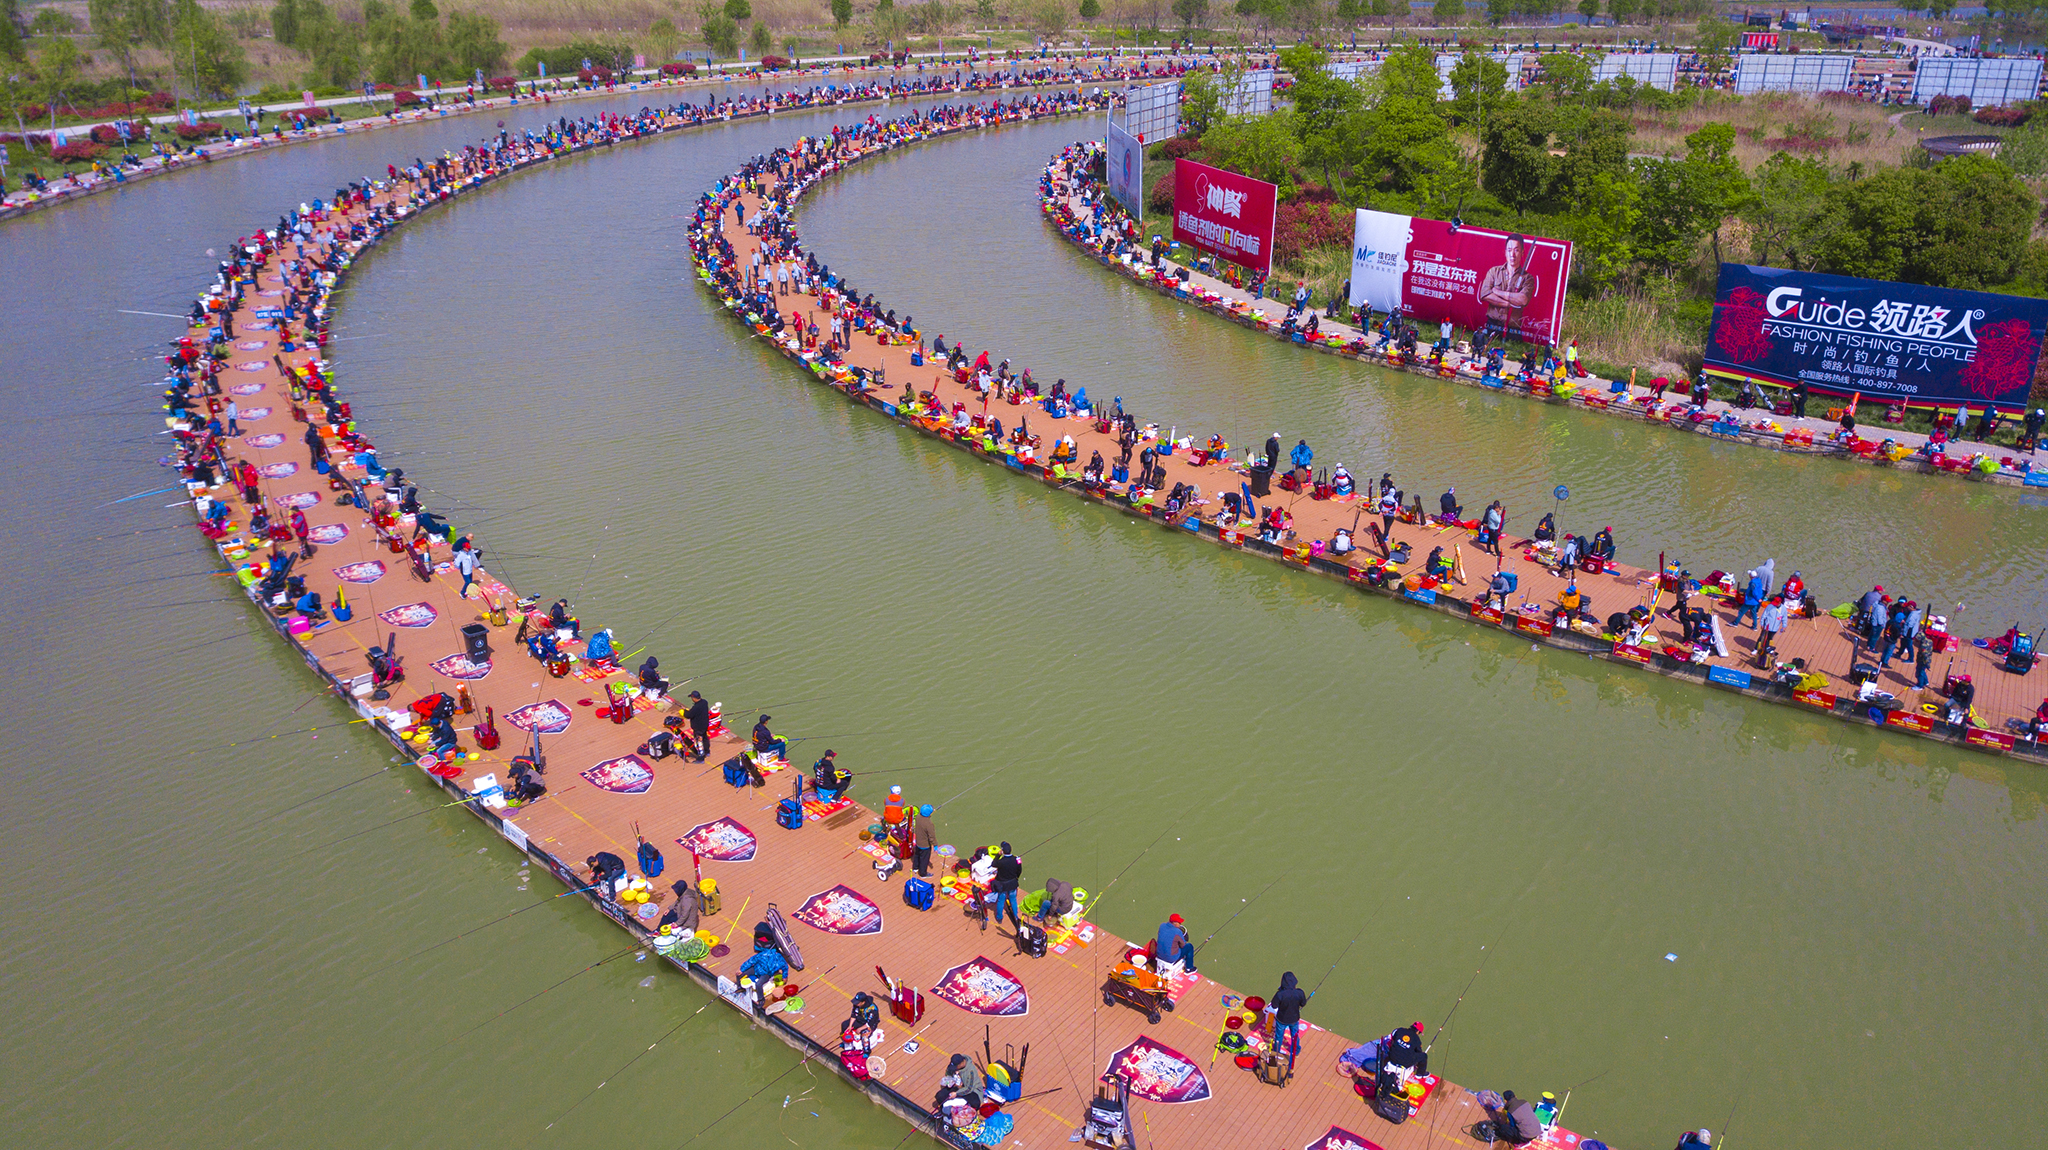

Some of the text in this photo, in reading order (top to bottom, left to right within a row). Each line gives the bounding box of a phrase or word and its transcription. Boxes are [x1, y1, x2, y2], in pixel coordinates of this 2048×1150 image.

[1411, 275, 1474, 295] 在我这没有漏网之鱼
[1412, 260, 1477, 284] 我是赵东来
[1766, 286, 1866, 327] Guide
[1869, 299, 1978, 344] 领路人
[1761, 323, 1977, 362] FASHION FISHING PEOPLE
[1821, 359, 1898, 379] 领路人国际钓具
